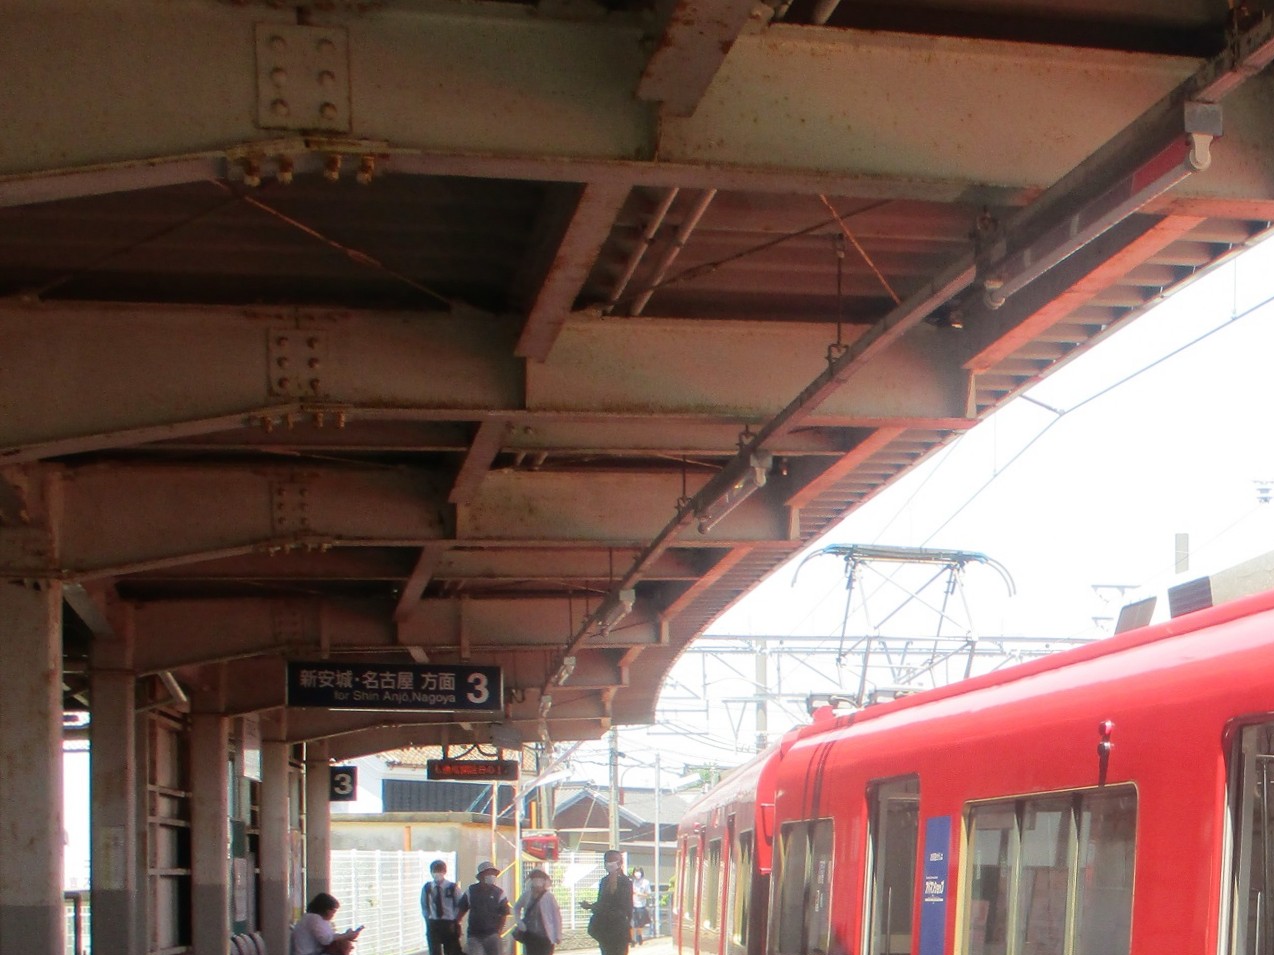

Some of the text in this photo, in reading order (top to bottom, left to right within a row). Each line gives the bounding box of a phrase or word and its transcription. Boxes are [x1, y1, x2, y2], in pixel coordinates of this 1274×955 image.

[421, 672, 456, 691] 方面
[466, 672, 490, 704] 3
[334, 691, 349, 700] for
[353, 691, 380, 701] Shin
[334, 773, 354, 795] 3
